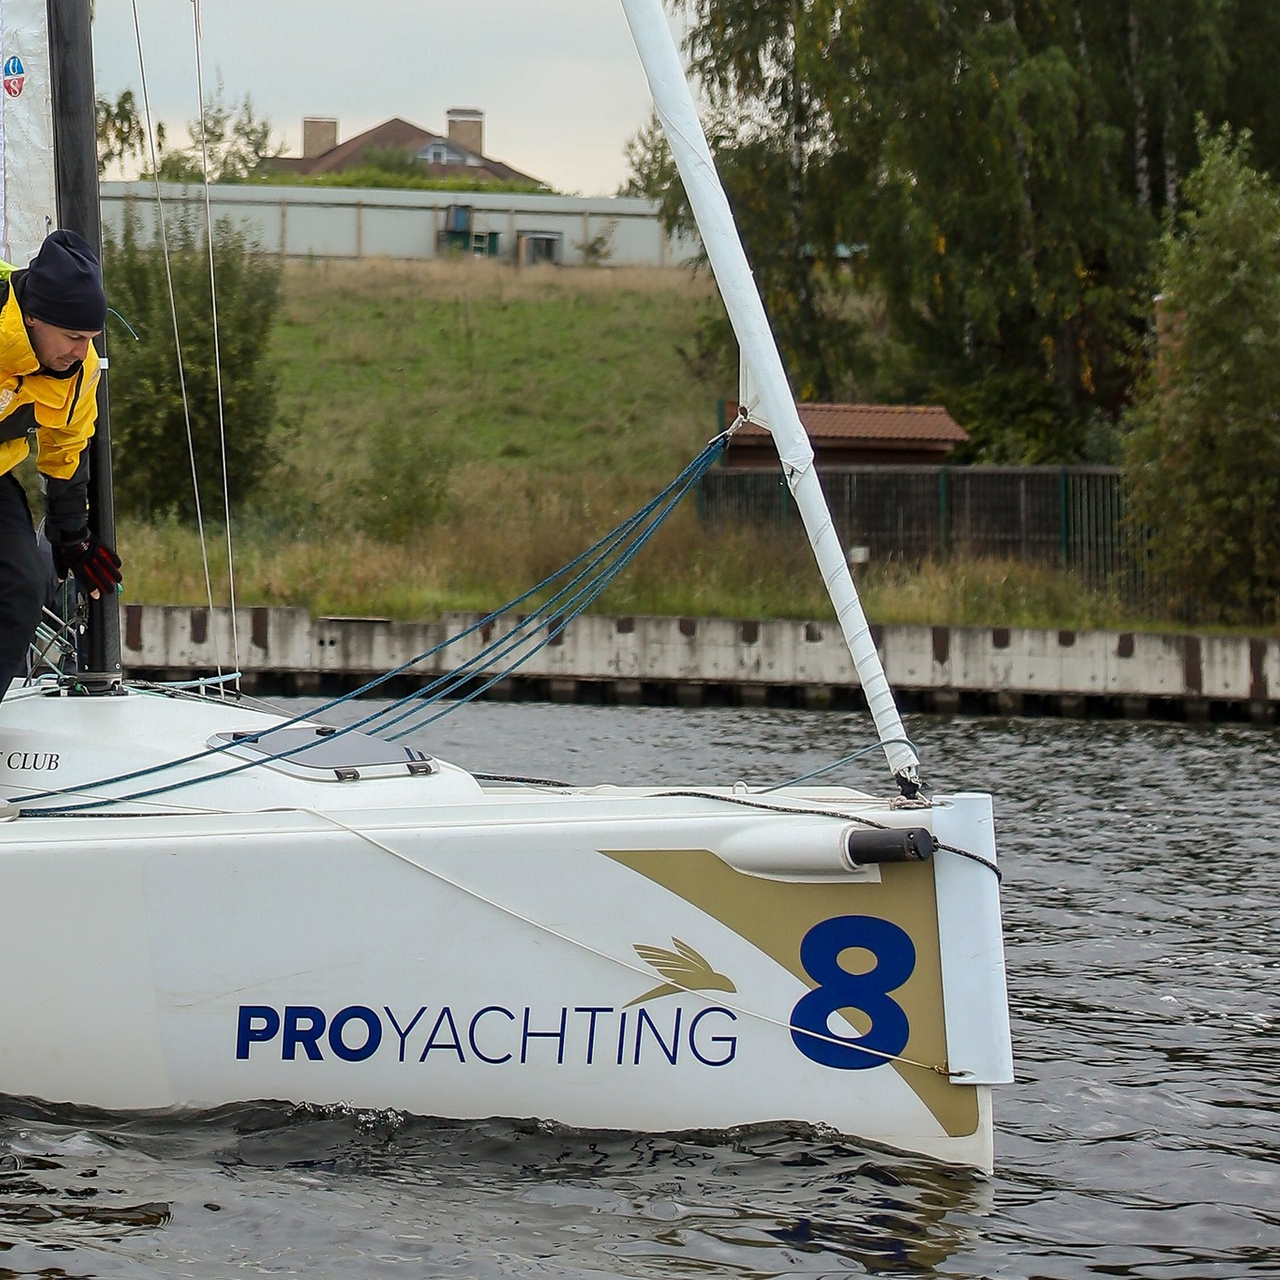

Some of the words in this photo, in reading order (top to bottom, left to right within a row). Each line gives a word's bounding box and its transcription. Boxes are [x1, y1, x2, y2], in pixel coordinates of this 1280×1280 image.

[6, 751, 60, 771] CLUB
[790, 915, 916, 1070] 8
[236, 1005, 738, 1067] PROYACHTING
